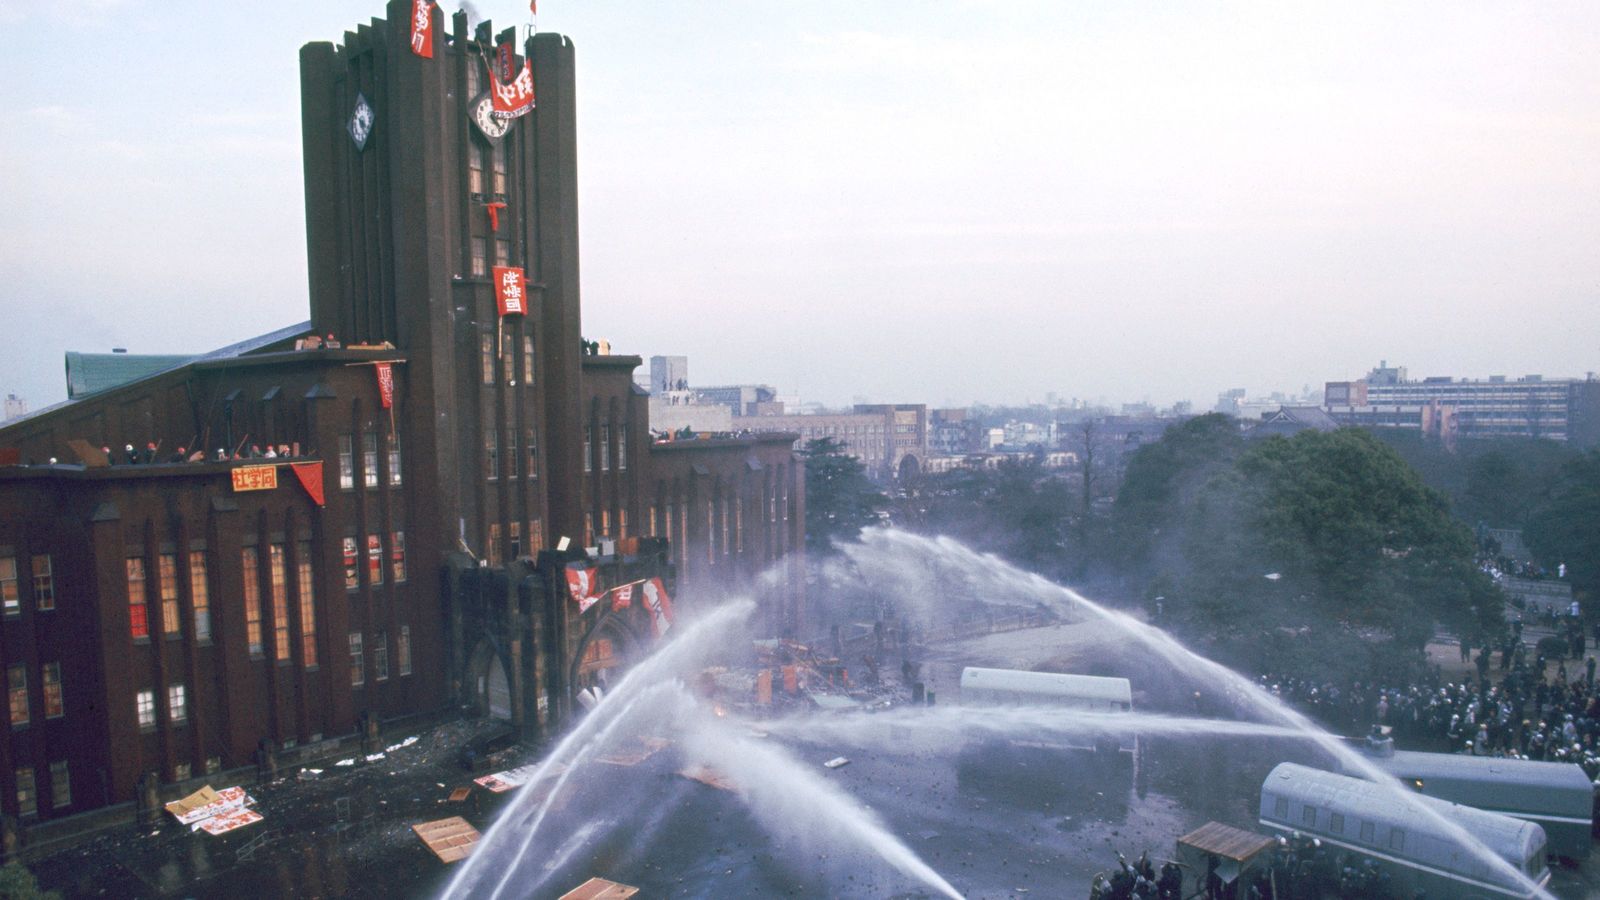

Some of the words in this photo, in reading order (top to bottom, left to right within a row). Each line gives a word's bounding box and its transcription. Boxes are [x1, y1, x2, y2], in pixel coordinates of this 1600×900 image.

[502, 270, 522, 312] 社学同
[232, 467, 275, 488] 社学同
